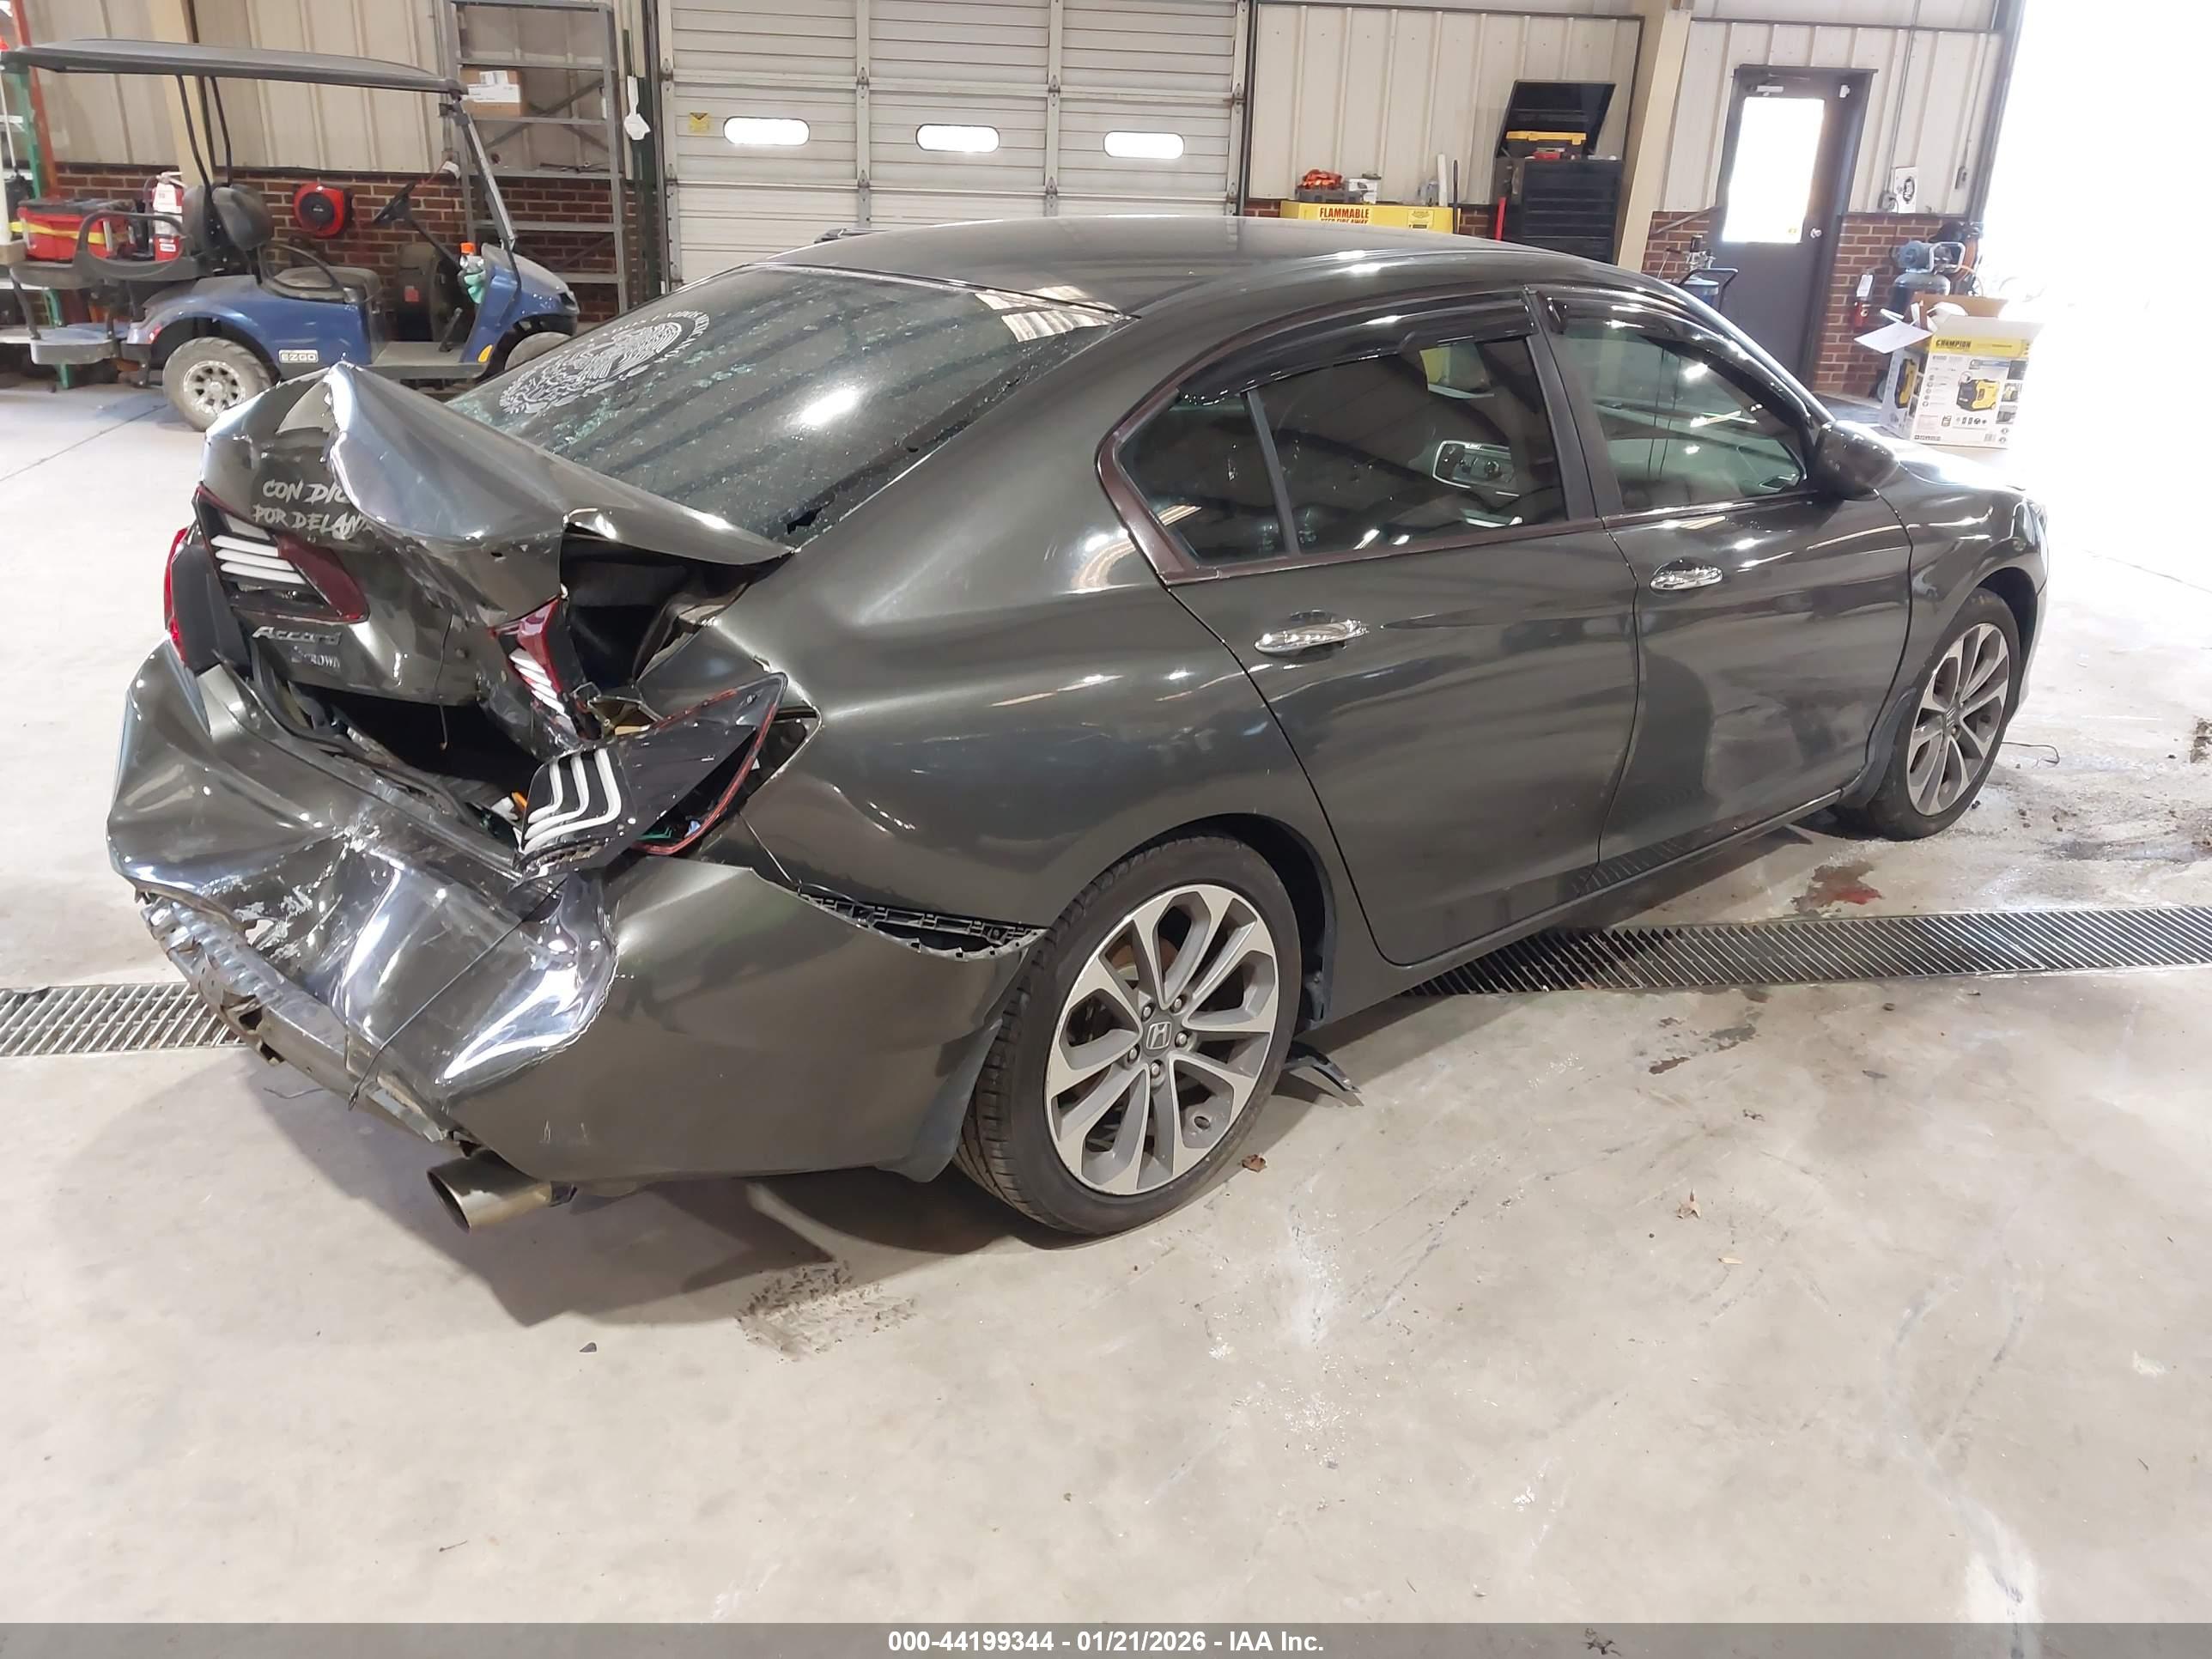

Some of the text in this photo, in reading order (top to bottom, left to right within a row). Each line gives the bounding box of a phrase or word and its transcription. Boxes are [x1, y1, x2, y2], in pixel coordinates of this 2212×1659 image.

[1320, 208, 1370, 218] FLAMMABLE
[1936, 339, 1972, 349] CHAMPION
[262, 478, 303, 503] CON
[252, 503, 289, 527] POR
[252, 626, 342, 645] Accord
